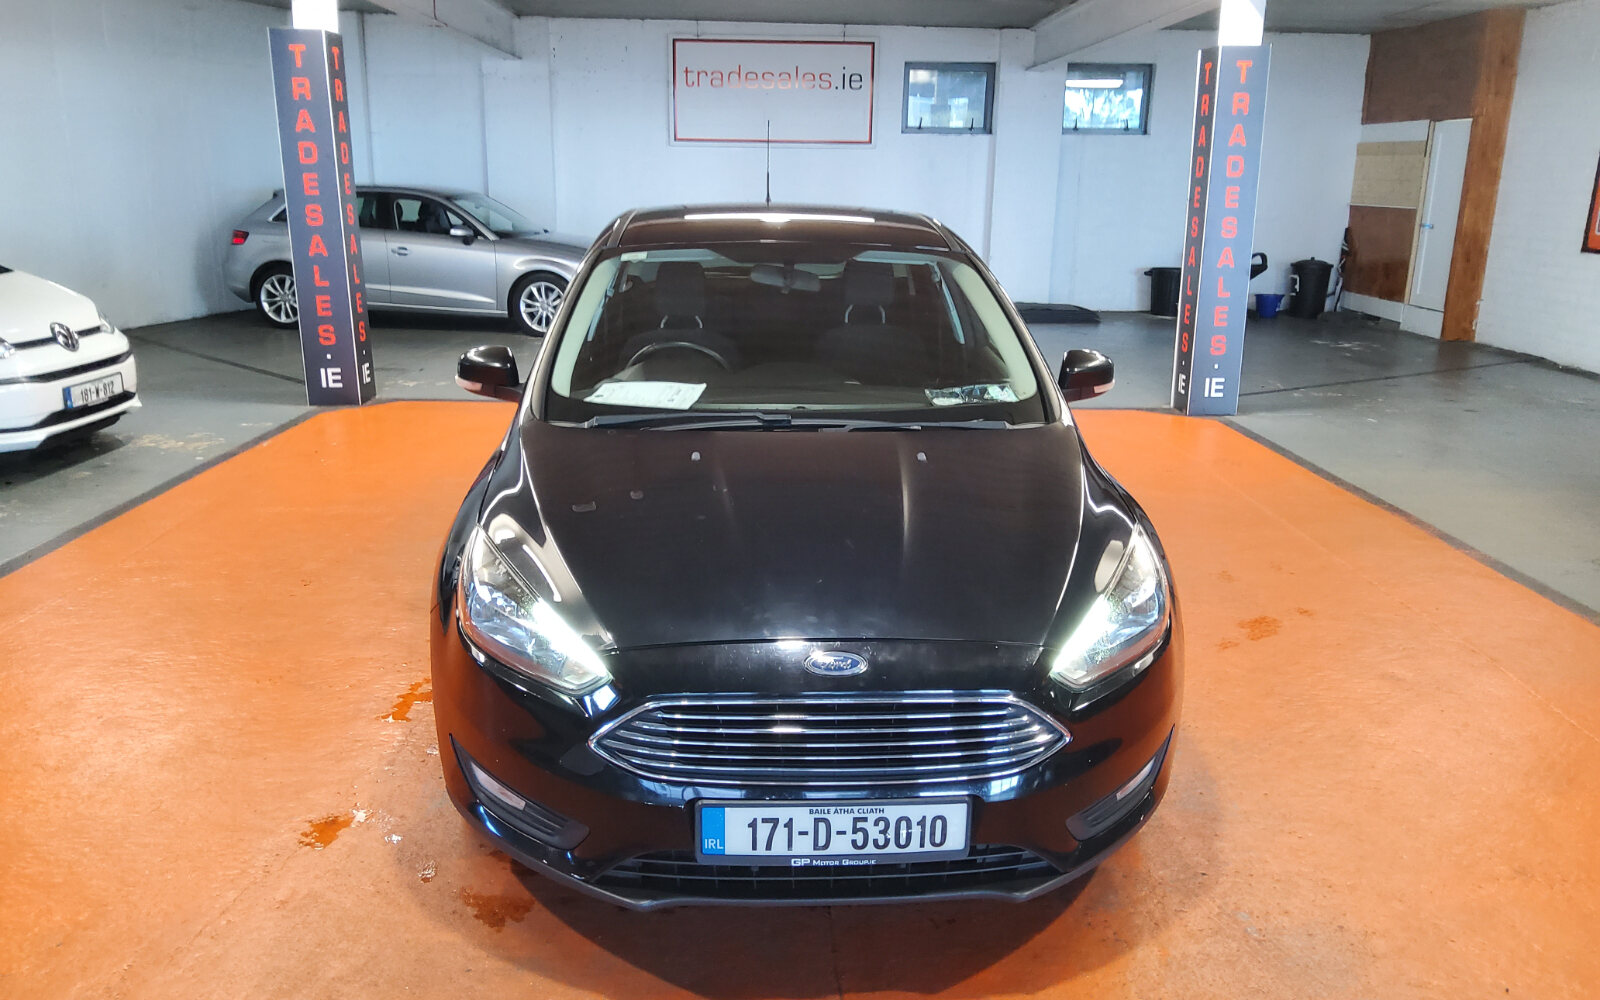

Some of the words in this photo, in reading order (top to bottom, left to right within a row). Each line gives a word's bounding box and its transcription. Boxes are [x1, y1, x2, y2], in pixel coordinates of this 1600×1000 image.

[683, 63, 863, 91] tradesales.ie
[833, 806, 855, 815] ÁTHA
[747, 814, 948, 852] 171-D-53010
[704, 838, 724, 850] IRL
[791, 858, 811, 867] GP
